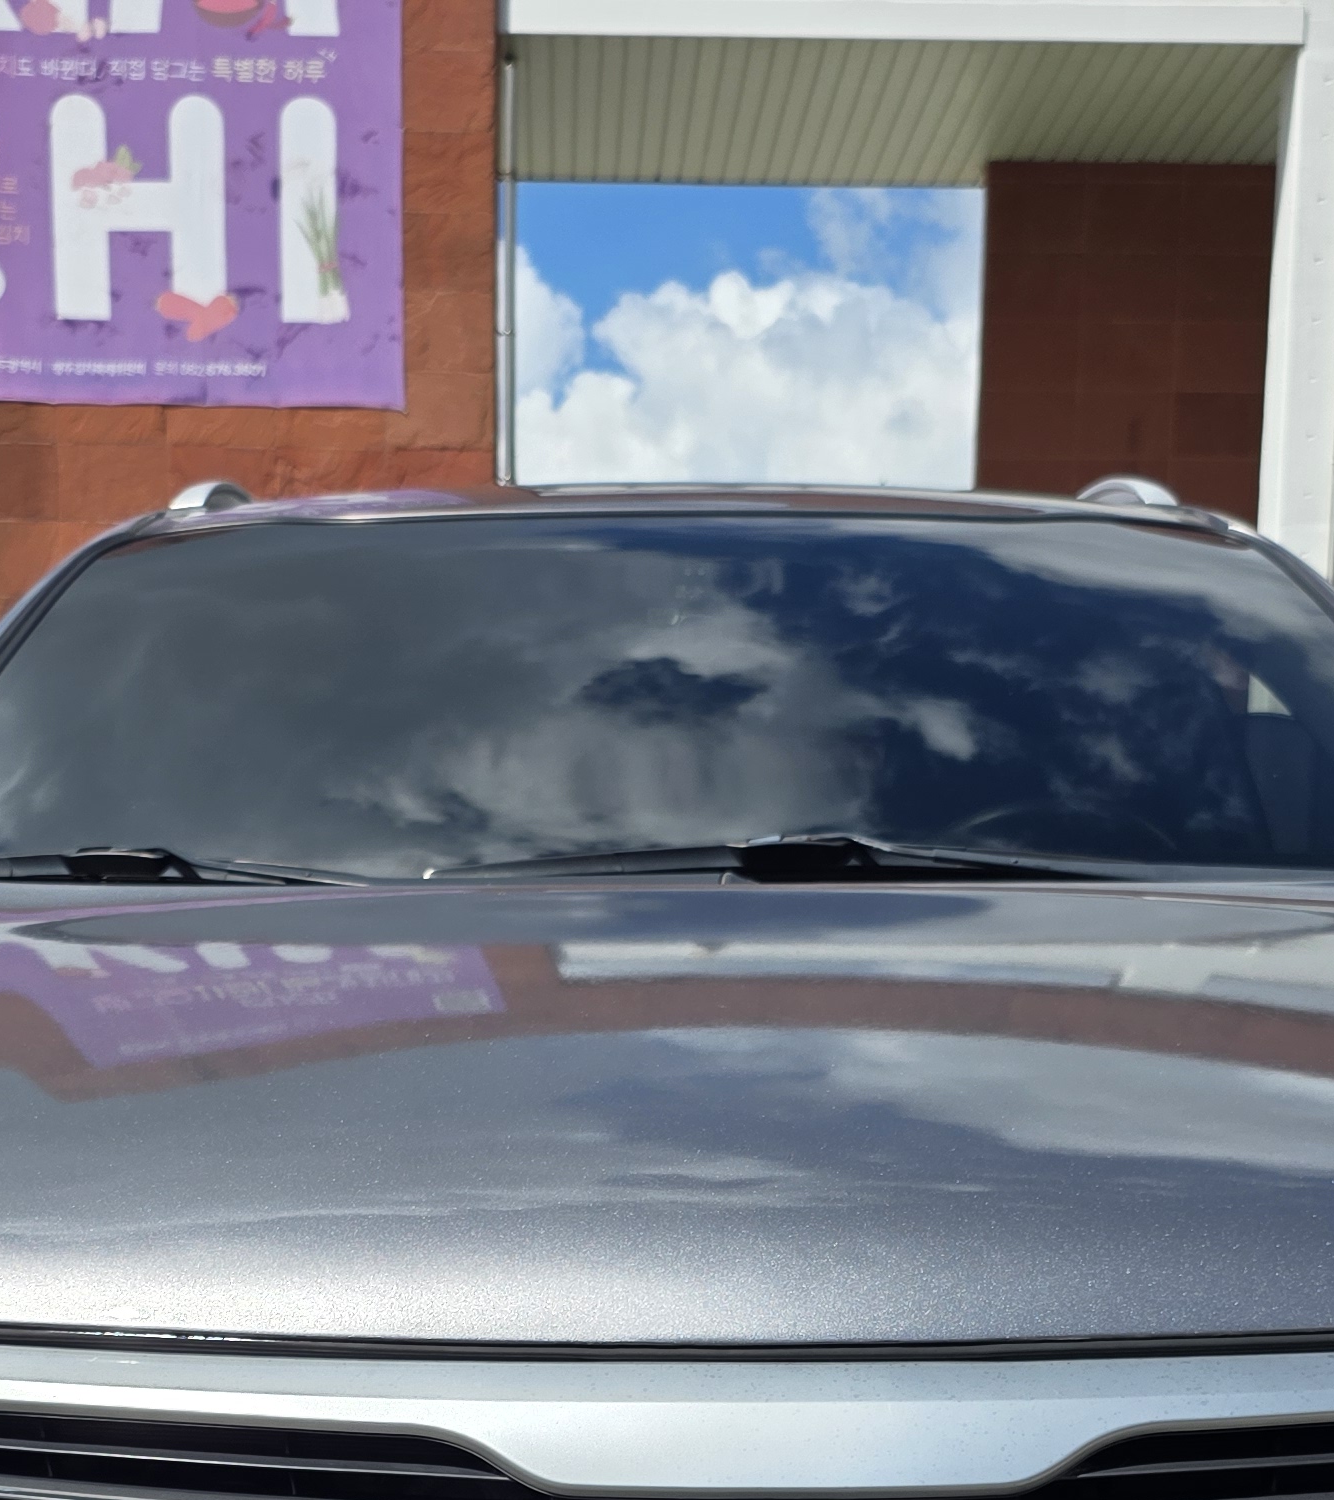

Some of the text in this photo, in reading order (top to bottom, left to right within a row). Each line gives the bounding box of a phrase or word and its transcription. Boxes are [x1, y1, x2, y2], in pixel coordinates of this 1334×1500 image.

[108, 57, 146, 81] 직접
[151, 59, 205, 82] 담그는
[212, 57, 277, 83] 특별한
[283, 59, 326, 84] 하루
